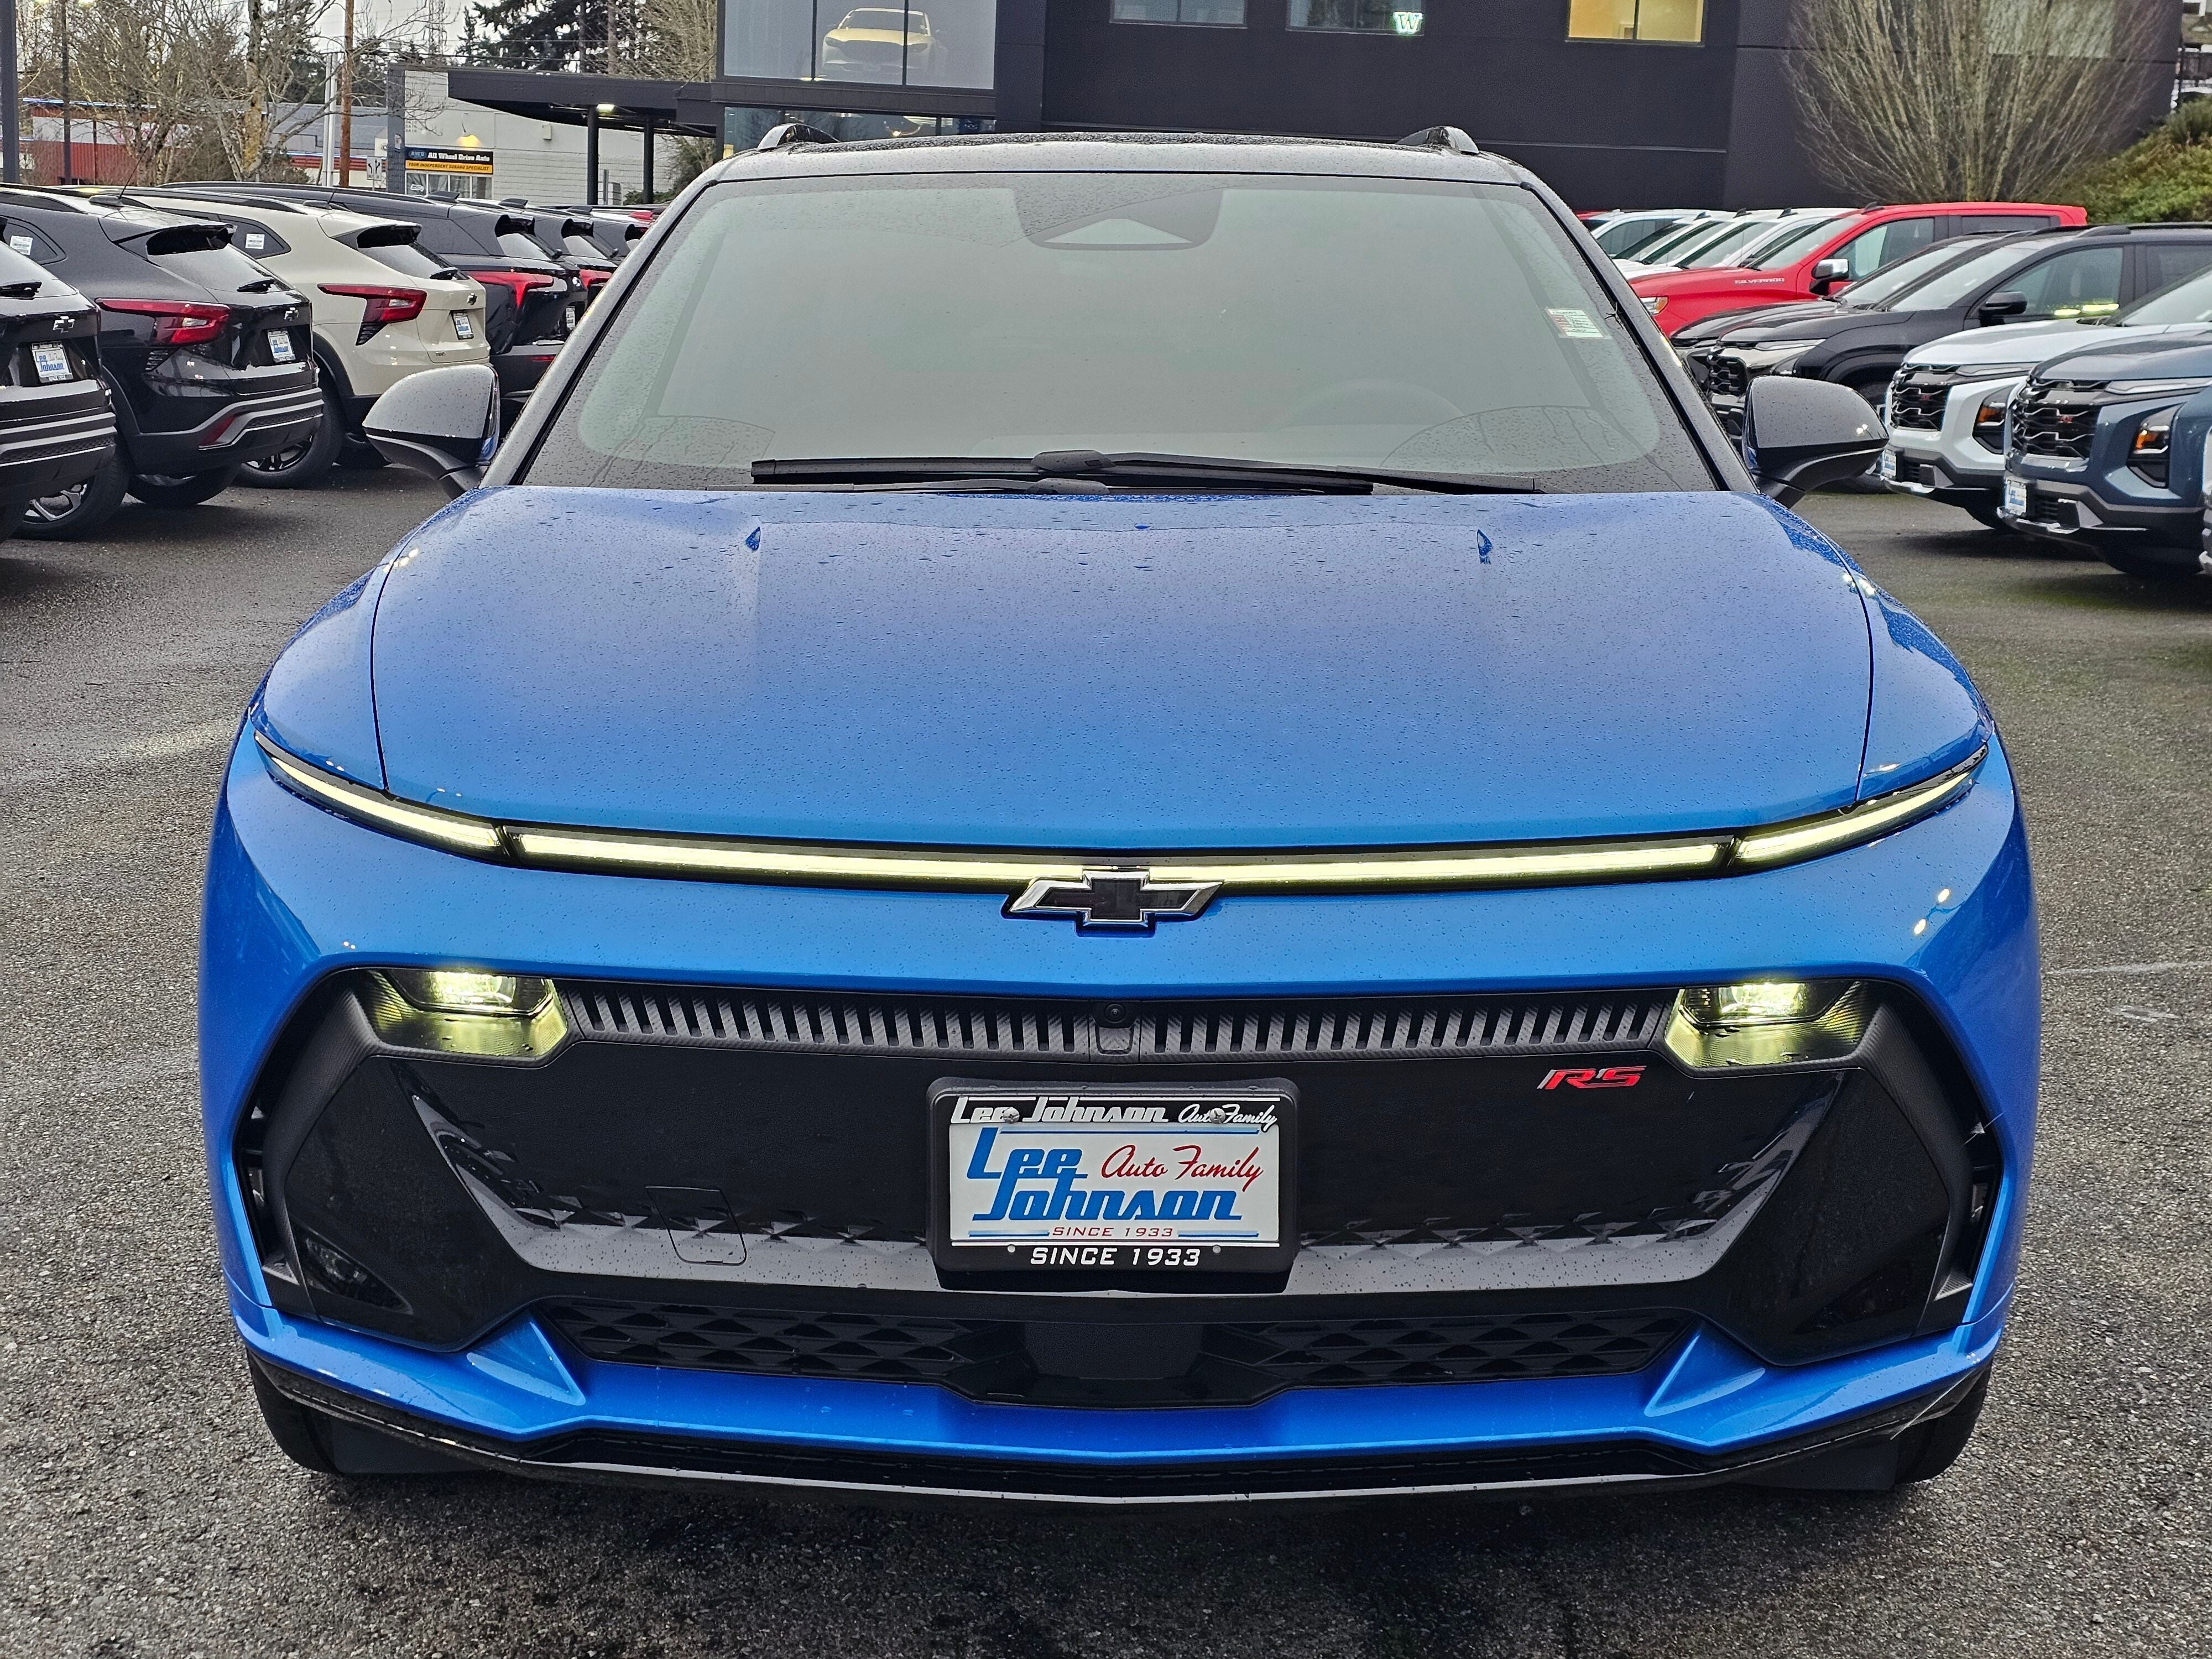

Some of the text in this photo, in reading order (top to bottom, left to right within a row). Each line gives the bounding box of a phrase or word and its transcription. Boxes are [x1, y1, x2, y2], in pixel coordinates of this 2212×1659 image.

[1393, 12, 1423, 33] W
[1537, 1065, 1647, 1090] RS
[1022, 1097, 1168, 1123] Johnson
[1222, 1104, 1277, 1132] Family
[967, 1127, 1264, 1192] Lee Auto Family
[972, 1175, 1243, 1220] Johnson
[1052, 1227, 1173, 1238] SINCE 1933
[1030, 1247, 1201, 1266] SINCE 1933
